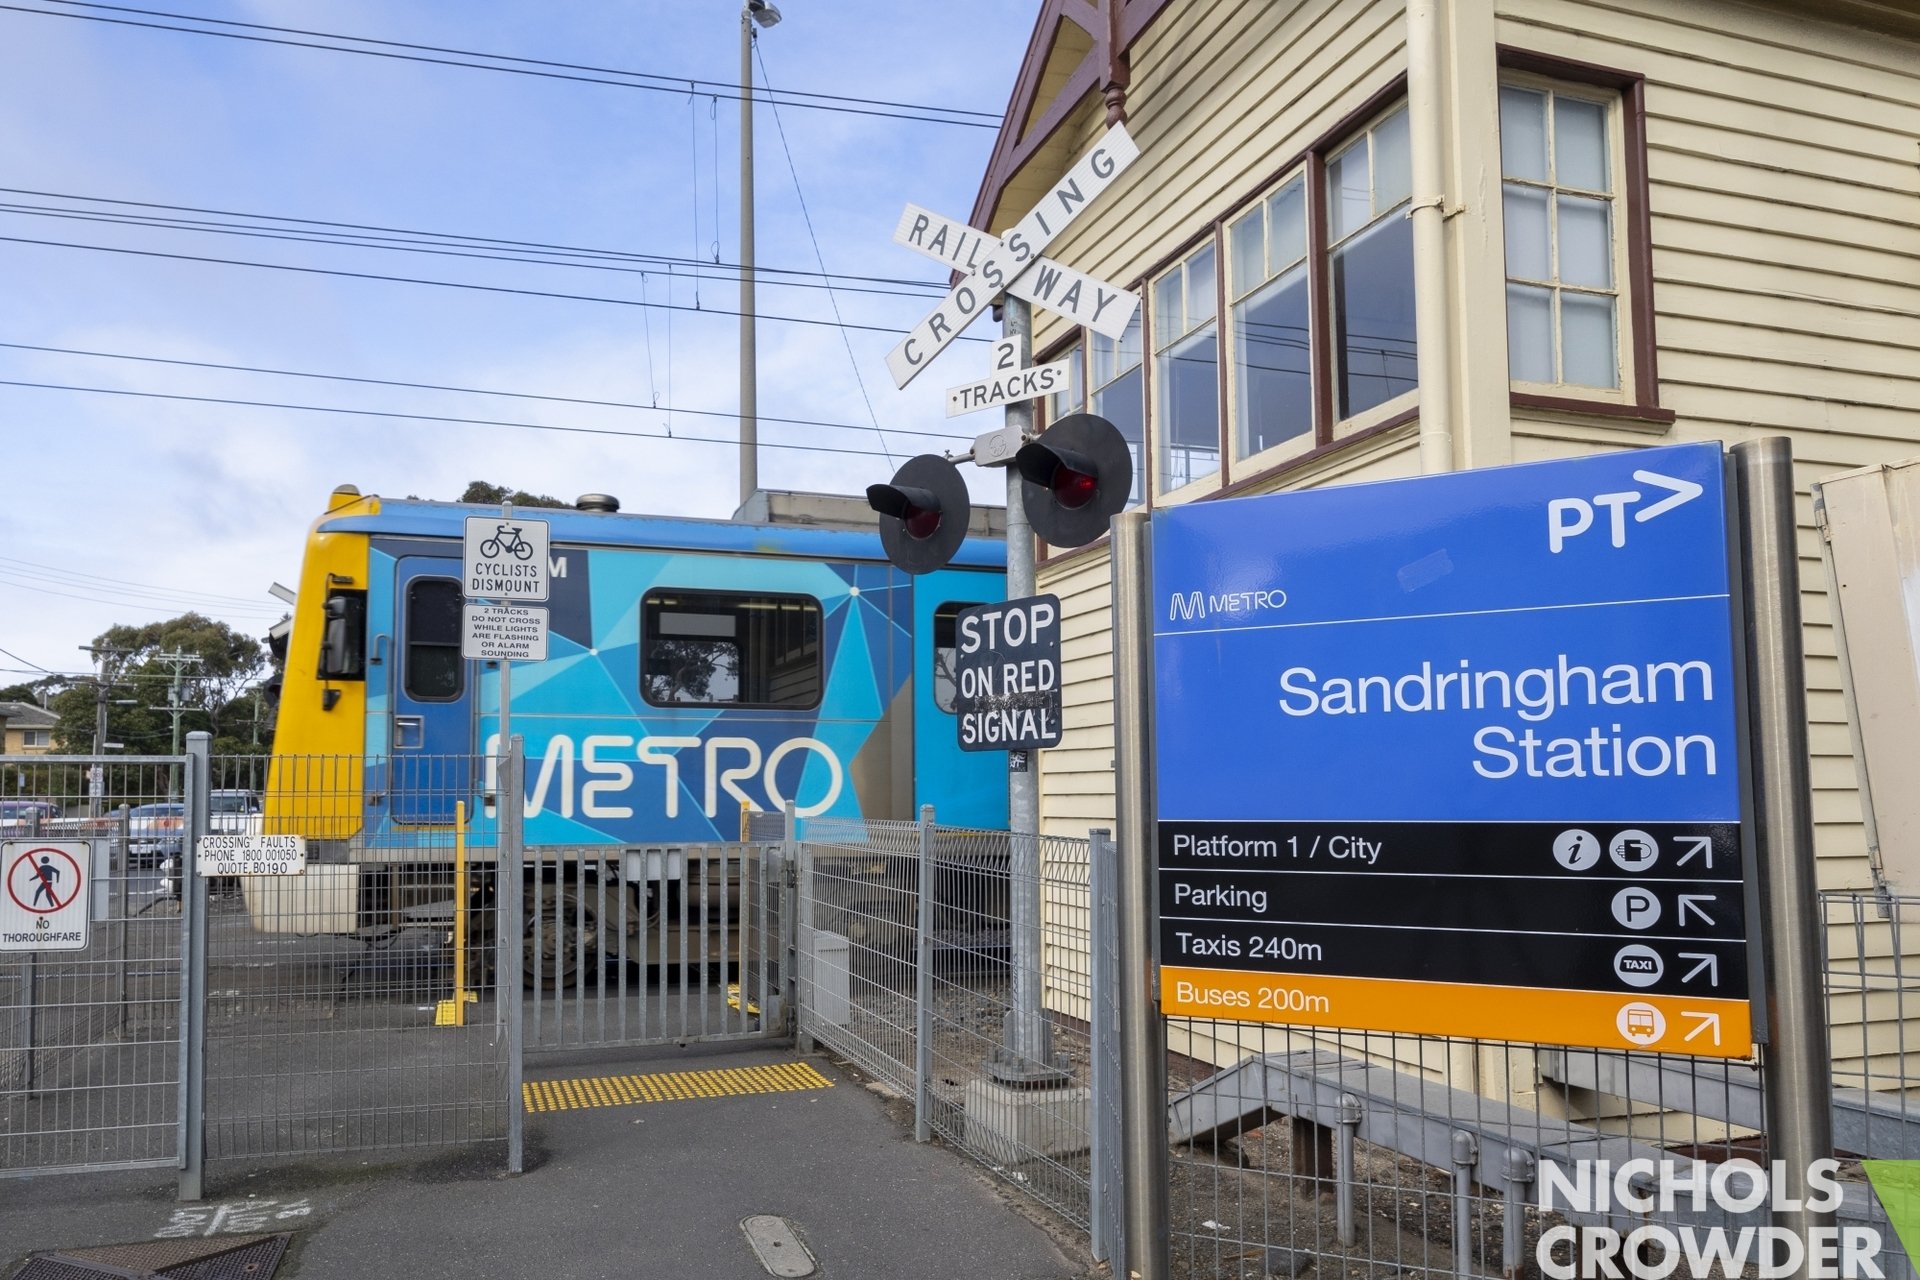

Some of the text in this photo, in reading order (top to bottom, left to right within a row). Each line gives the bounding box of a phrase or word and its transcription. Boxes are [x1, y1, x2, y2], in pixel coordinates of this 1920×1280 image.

[904, 148, 1115, 366] CROSSING
[997, 342, 1014, 370] 2
[959, 367, 1054, 409] TRACKS
[475, 562, 537, 578] CYCLISTS
[472, 578, 540, 593] DISMOUNT
[492, 607, 529, 616] TRACKS
[1209, 589, 1287, 613] METRO
[505, 625, 538, 633] LIGHTS
[509, 617, 541, 625] CROSS
[961, 603, 1055, 654] STOP
[481, 650, 529, 658] SOUNDING
[961, 659, 1055, 698] ON RED
[1279, 653, 1713, 721] Sandringham
[962, 708, 1057, 744] SIGNAL
[1472, 723, 1716, 779] Station
[485, 733, 843, 819] METRO
[203, 836, 296, 848] CROSSING FAULTS
[204, 850, 235, 861] PHONE
[242, 849, 262, 861] 1800
[1173, 834, 1277, 858] Platform
[1287, 836, 1298, 858] 1
[1328, 835, 1382, 865] City
[1174, 883, 1267, 913] Parking
[2, 932, 82, 943] THOROUGHFARE
[36, 920, 50, 929] NO
[1175, 932, 1322, 961] Taxis 240m
[1623, 959, 1652, 970] TAXI
[1176, 981, 1329, 1013] Buses 200m
